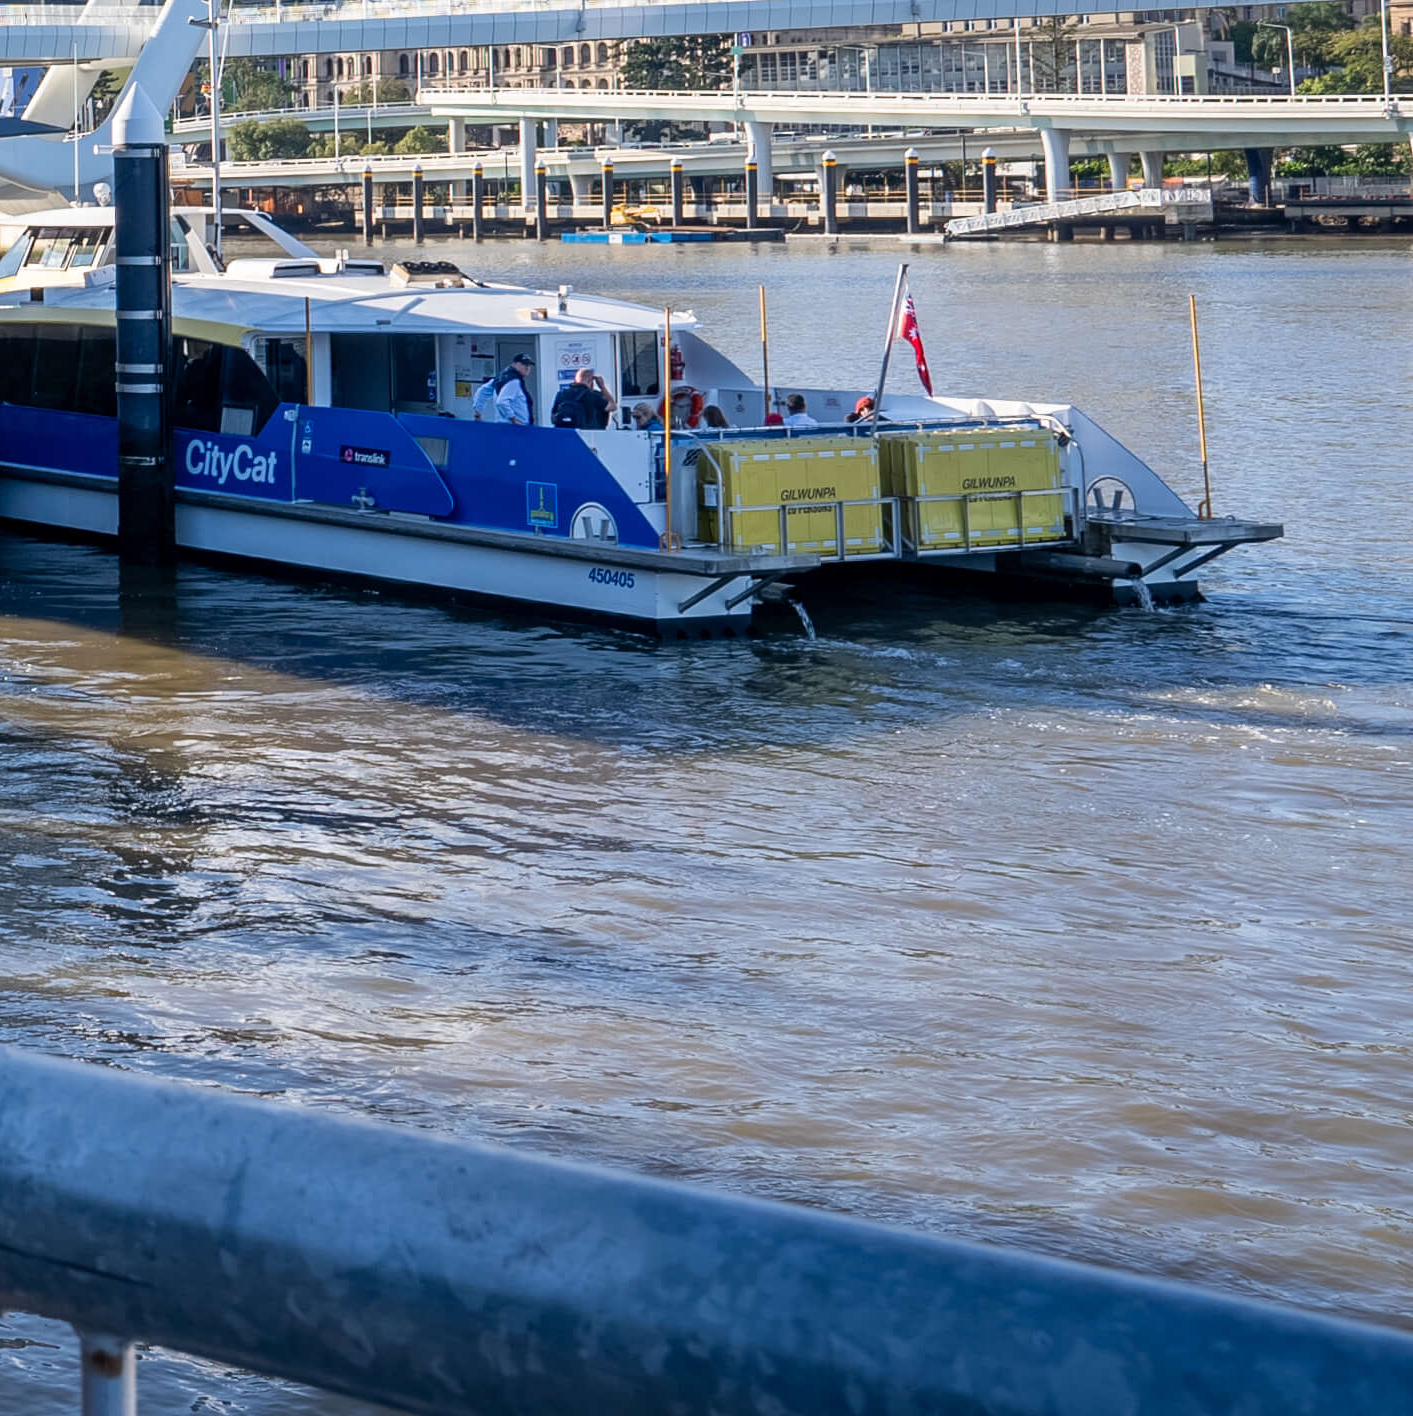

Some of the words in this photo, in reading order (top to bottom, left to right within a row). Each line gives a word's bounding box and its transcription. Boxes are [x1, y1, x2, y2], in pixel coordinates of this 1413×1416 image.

[186, 439, 277, 485] CityCat
[354, 451, 386, 465] translink
[962, 475, 1016, 490] GILWUNPA
[781, 486, 837, 502] GILWUNPA
[589, 568, 636, 589] 450405
